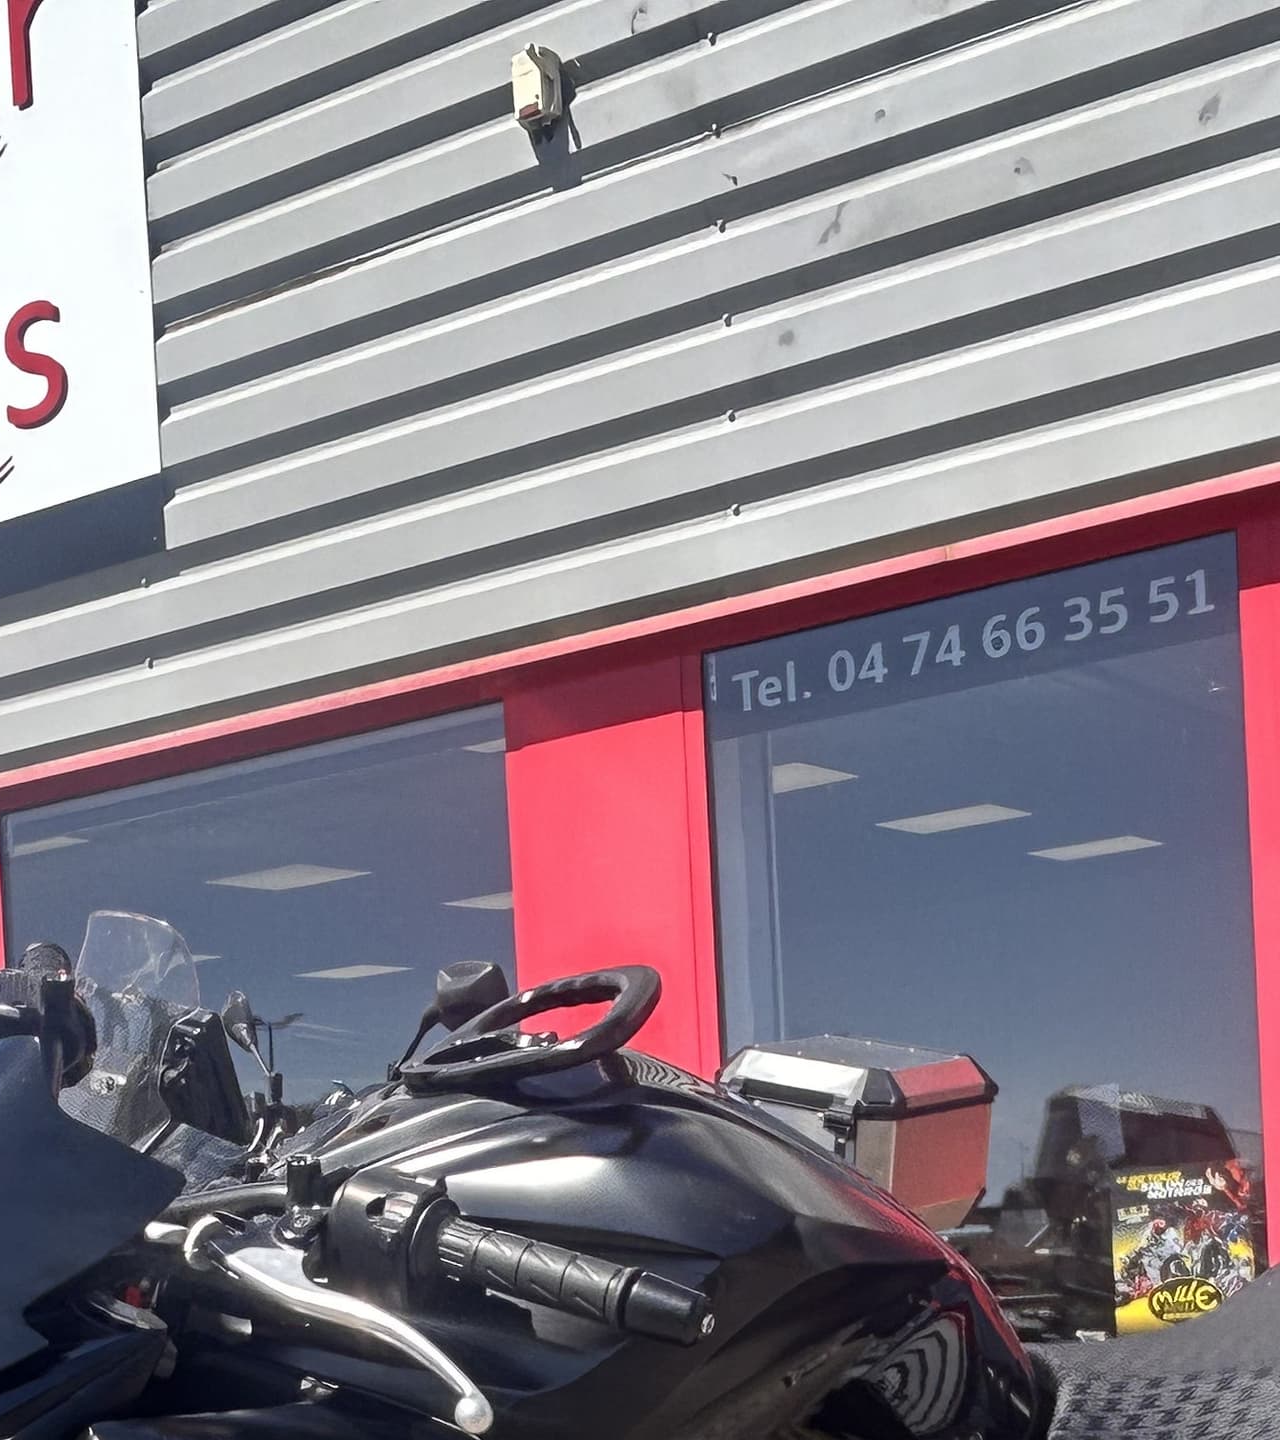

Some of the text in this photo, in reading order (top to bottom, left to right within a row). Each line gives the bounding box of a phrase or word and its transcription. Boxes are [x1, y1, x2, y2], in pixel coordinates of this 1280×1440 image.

[732, 569, 1215, 712] Tel. 04 74 66 35 51
